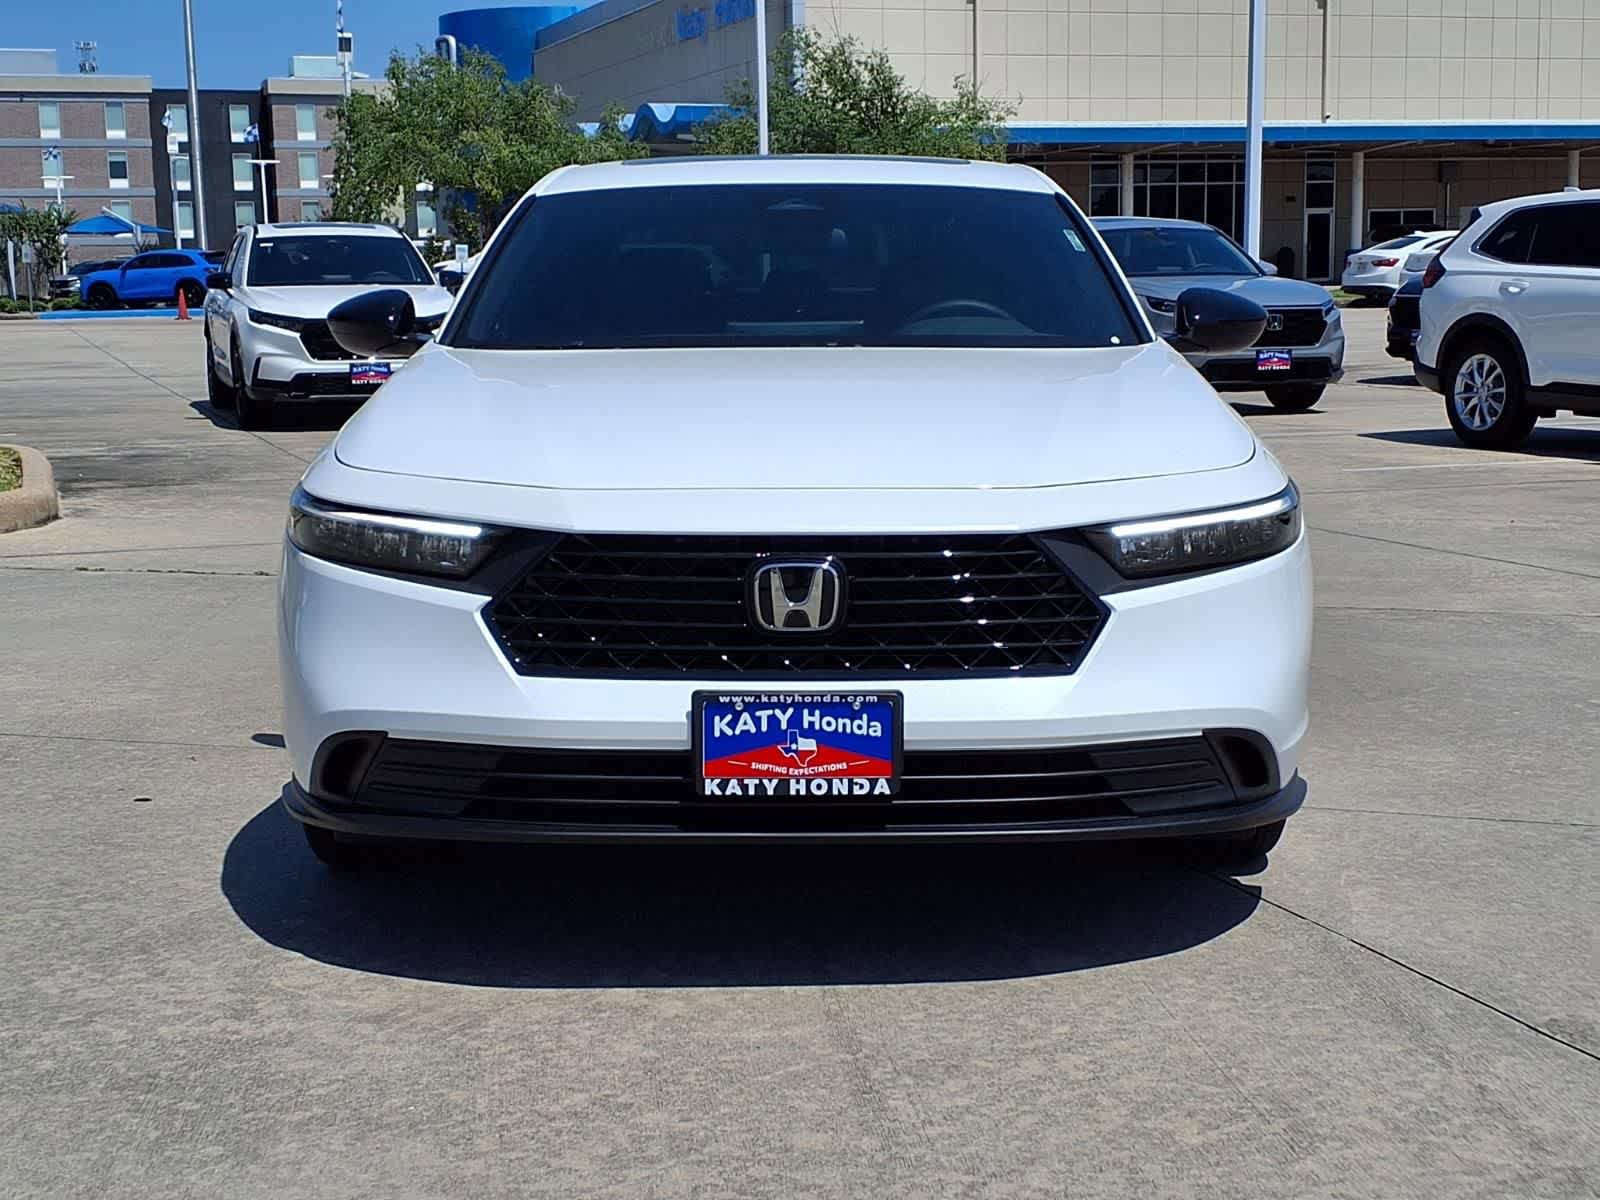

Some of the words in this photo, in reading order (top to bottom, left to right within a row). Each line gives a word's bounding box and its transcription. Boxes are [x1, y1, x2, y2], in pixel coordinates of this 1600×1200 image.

[719, 694, 878, 704] www.katyhonda.com
[713, 707, 794, 738] KATY
[802, 708, 882, 737] Honda
[751, 762, 788, 775] SHIFTING
[788, 762, 848, 776] EXPECTATIONS
[704, 778, 780, 796] KATY
[789, 778, 892, 796] HONDA
